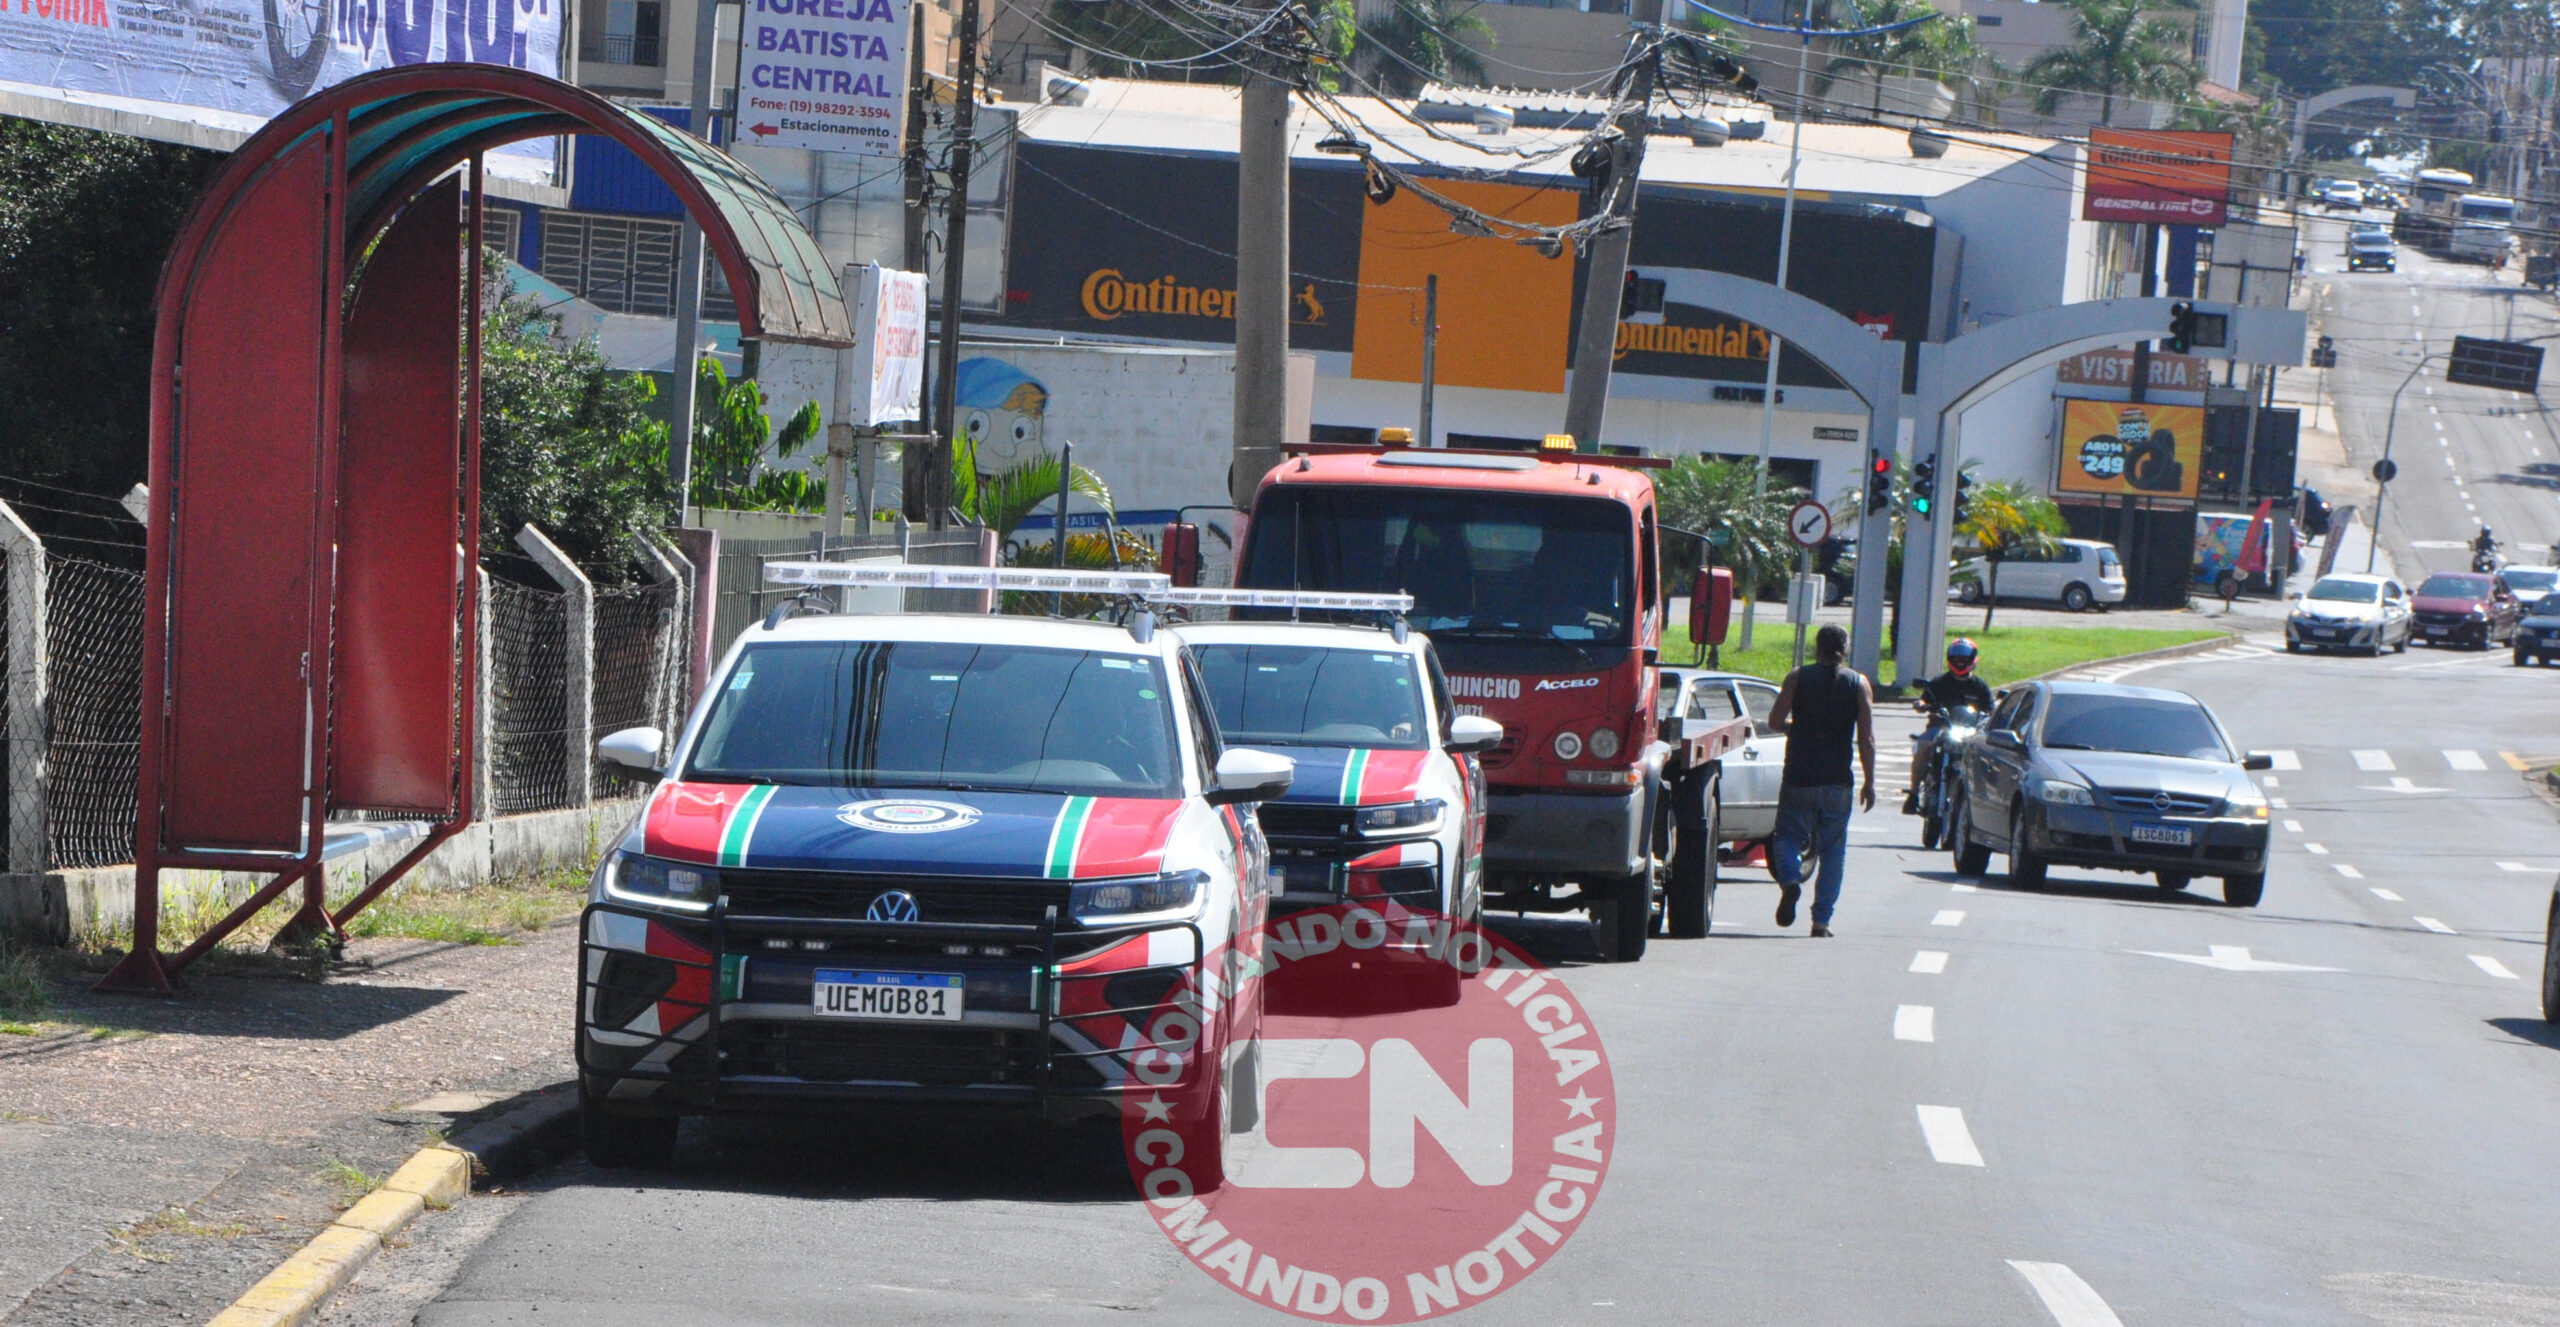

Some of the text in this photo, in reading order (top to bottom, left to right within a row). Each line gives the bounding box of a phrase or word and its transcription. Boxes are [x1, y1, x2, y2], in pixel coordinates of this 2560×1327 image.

[757, 26, 889, 61] BATISTA
[752, 64, 891, 98] CENTRAL
[751, 97, 891, 119] Fone: (19) 98292-3594
[780, 118, 890, 138] Estacionamento
[2093, 198, 2191, 212] GENERAL TIRE
[1081, 268, 1238, 320] Continen
[1613, 316, 1749, 360] ontinental
[2080, 355, 2188, 386] VISTRIA
[2084, 455, 2125, 473] 249
[1051, 515, 1099, 527] BASIL
[876, 976, 901, 984] BRASIL
